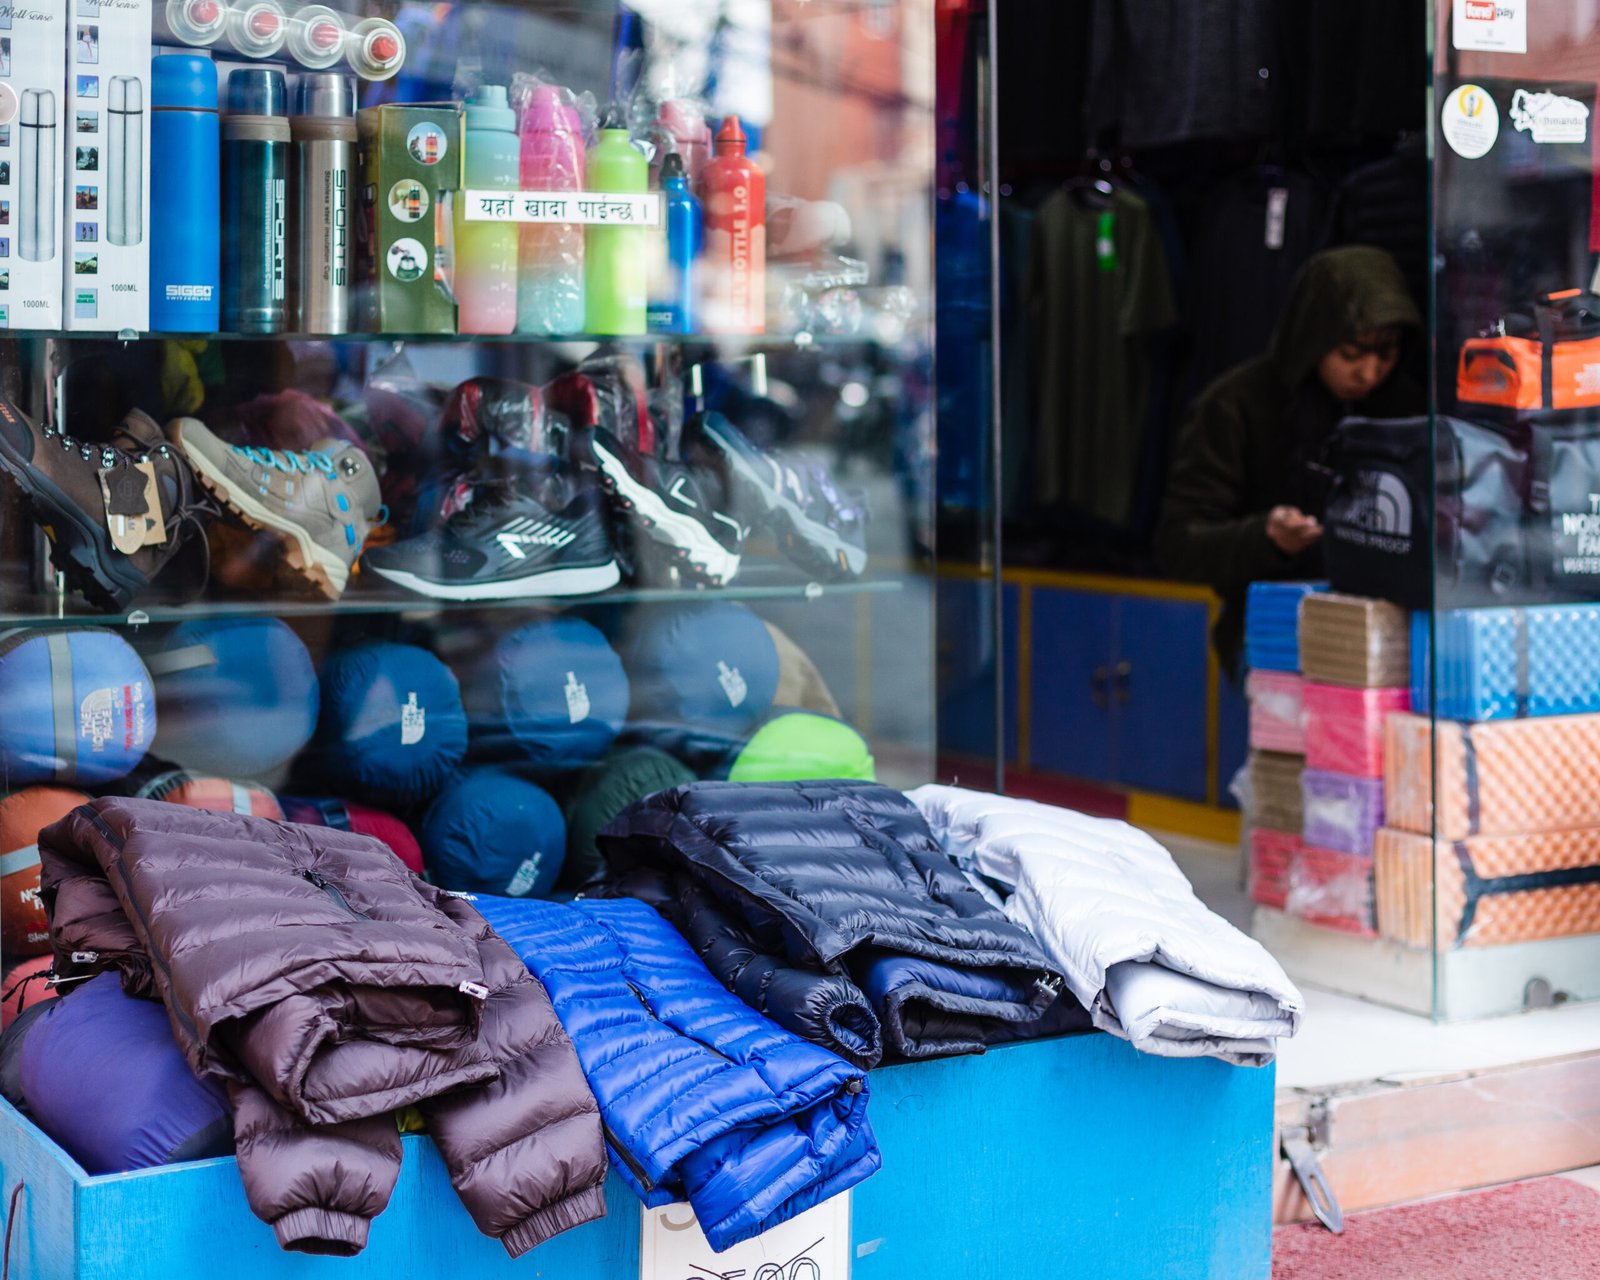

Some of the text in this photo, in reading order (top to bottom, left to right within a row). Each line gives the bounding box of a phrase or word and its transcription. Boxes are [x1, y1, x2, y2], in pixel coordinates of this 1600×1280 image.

[0, 6, 54, 22] Well sense
[323, 170, 331, 203] Stainless
[733, 185, 747, 212] 1.0
[323, 206, 331, 224] steel
[479, 194, 515, 217] यहाँ
[524, 199, 568, 218] खादा
[275, 179, 285, 300] SPORTS
[336, 169, 346, 287] SPORTS
[733, 219, 747, 281] BOTTLE
[322, 265, 331, 281] Cup
[111, 284, 138, 292] 1000ML
[165, 285, 212, 297] SIGGO
[22, 300, 51, 308] 1000ML
[80, 711, 93, 738] THE
[92, 710, 104, 752] NORTH
[102, 708, 113, 739] FACE
